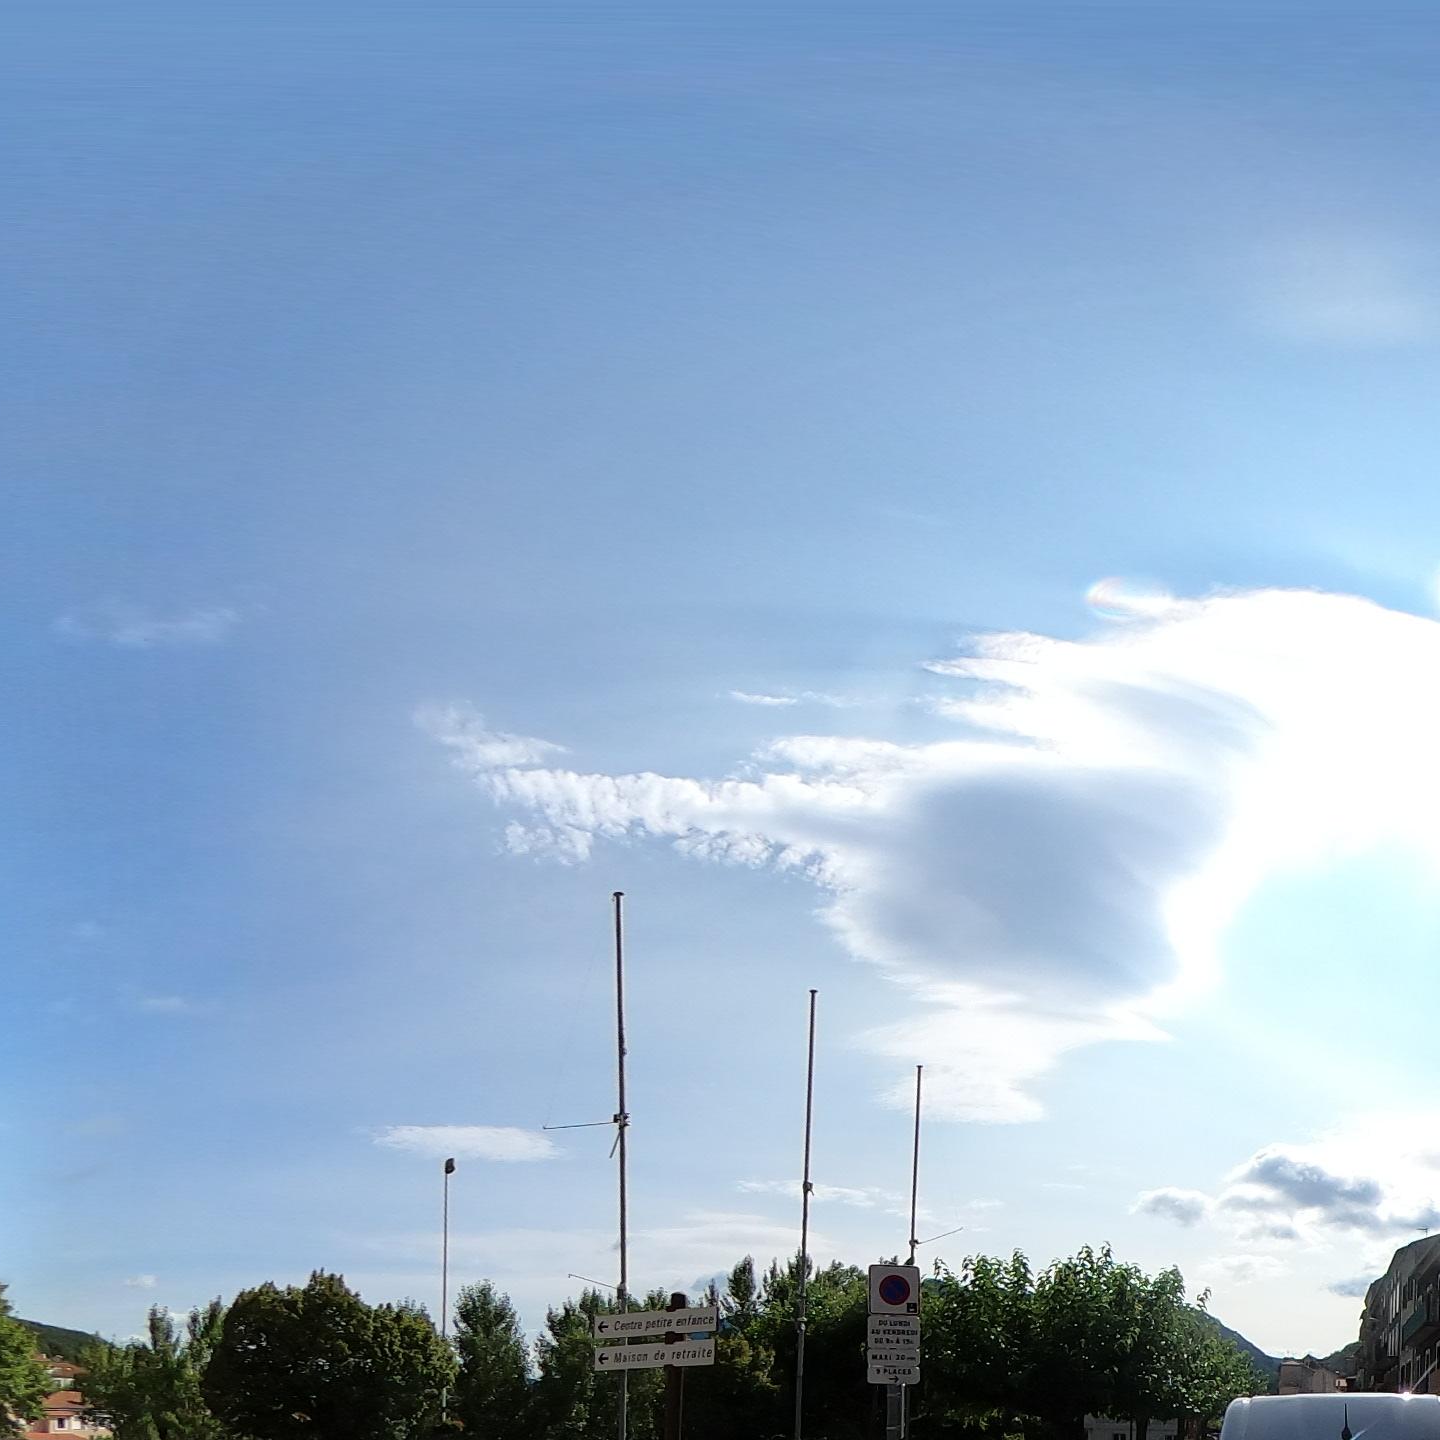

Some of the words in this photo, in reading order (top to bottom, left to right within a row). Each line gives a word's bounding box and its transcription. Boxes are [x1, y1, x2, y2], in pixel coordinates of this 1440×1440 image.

[614, 1320, 643, 1331] Centre
[645, 1317, 673, 1331] petite
[676, 1315, 714, 1327] enfance
[613, 1351, 648, 1363] Maison
[654, 1350, 666, 1360] de
[672, 1347, 713, 1360] retraite
